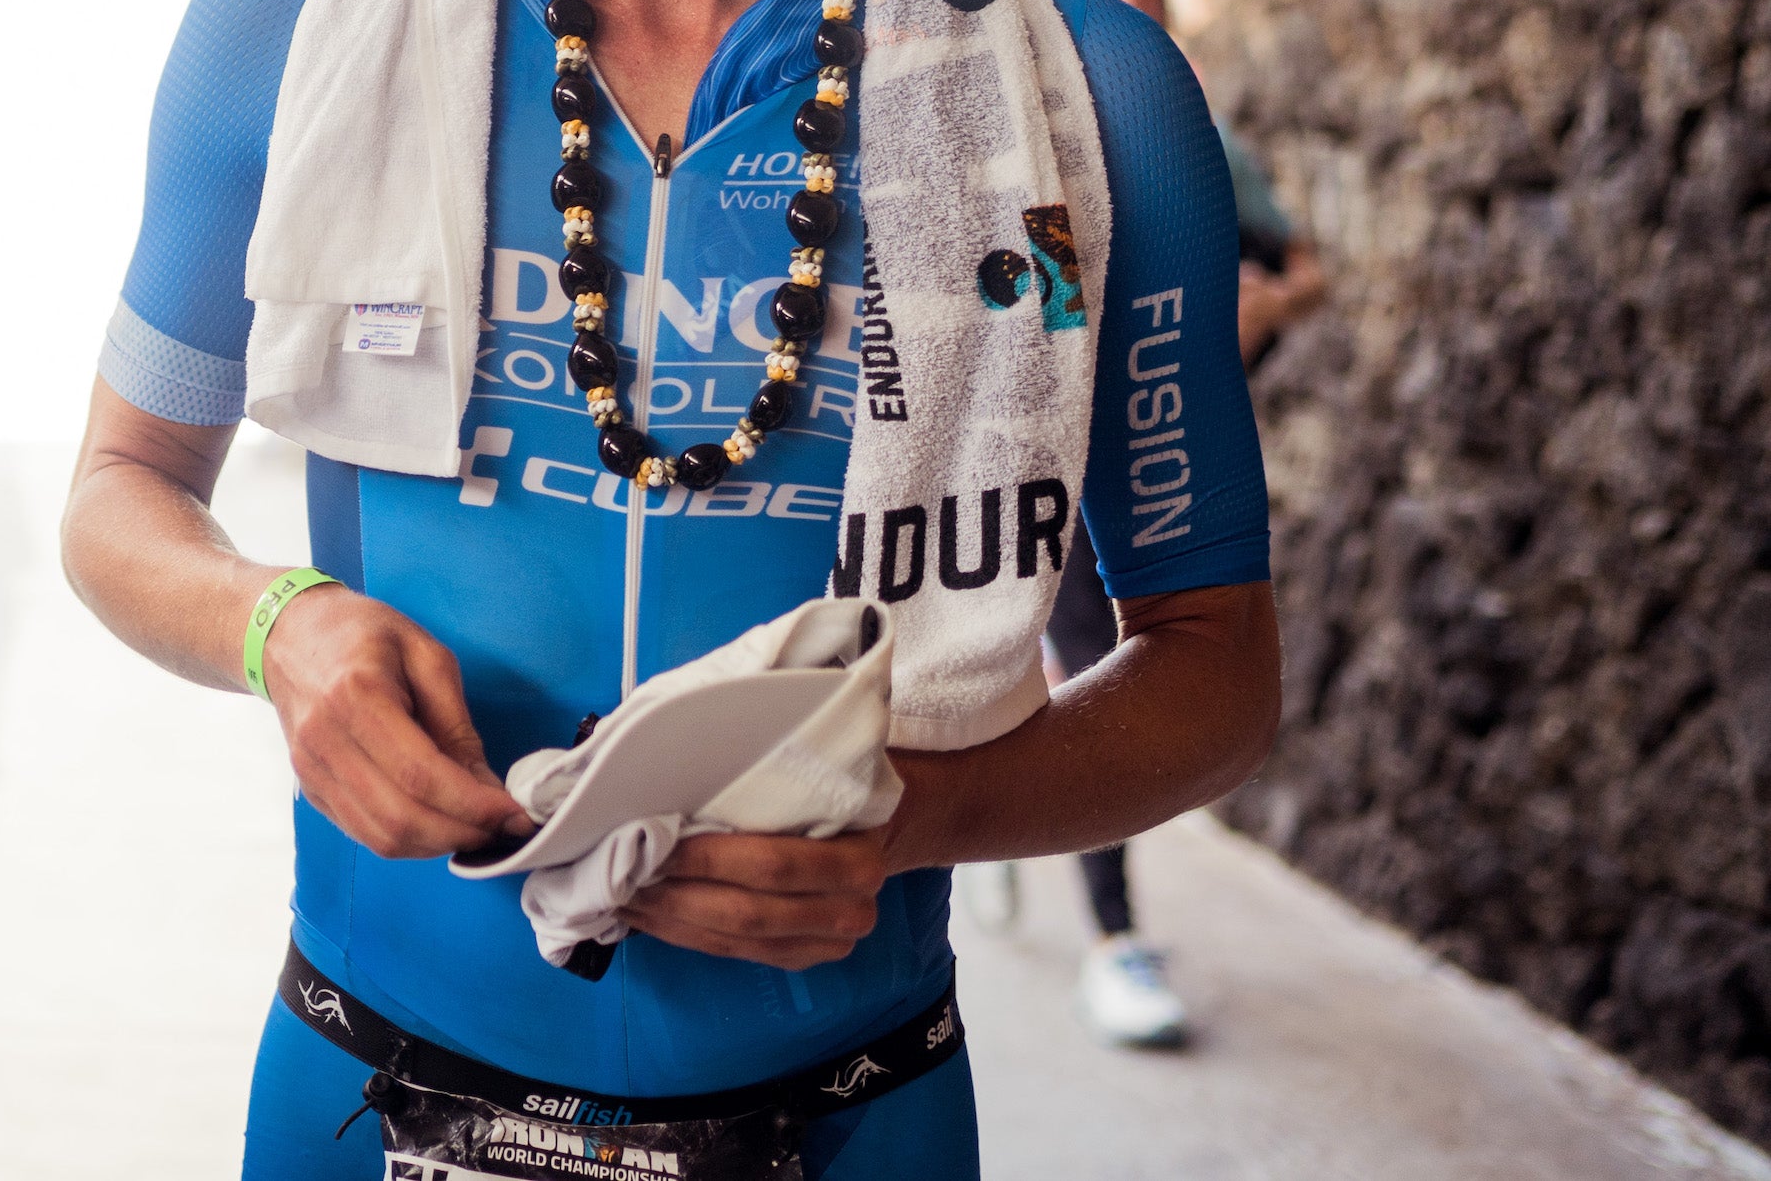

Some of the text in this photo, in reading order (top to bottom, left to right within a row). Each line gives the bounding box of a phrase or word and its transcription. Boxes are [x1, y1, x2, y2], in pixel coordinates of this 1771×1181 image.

[1129, 287, 1192, 548] FUSION
[521, 457, 844, 521] CUBE
[256, 580, 296, 627] PRO
[522, 1094, 633, 1127] sailfish
[487, 1145, 547, 1167] WORLD
